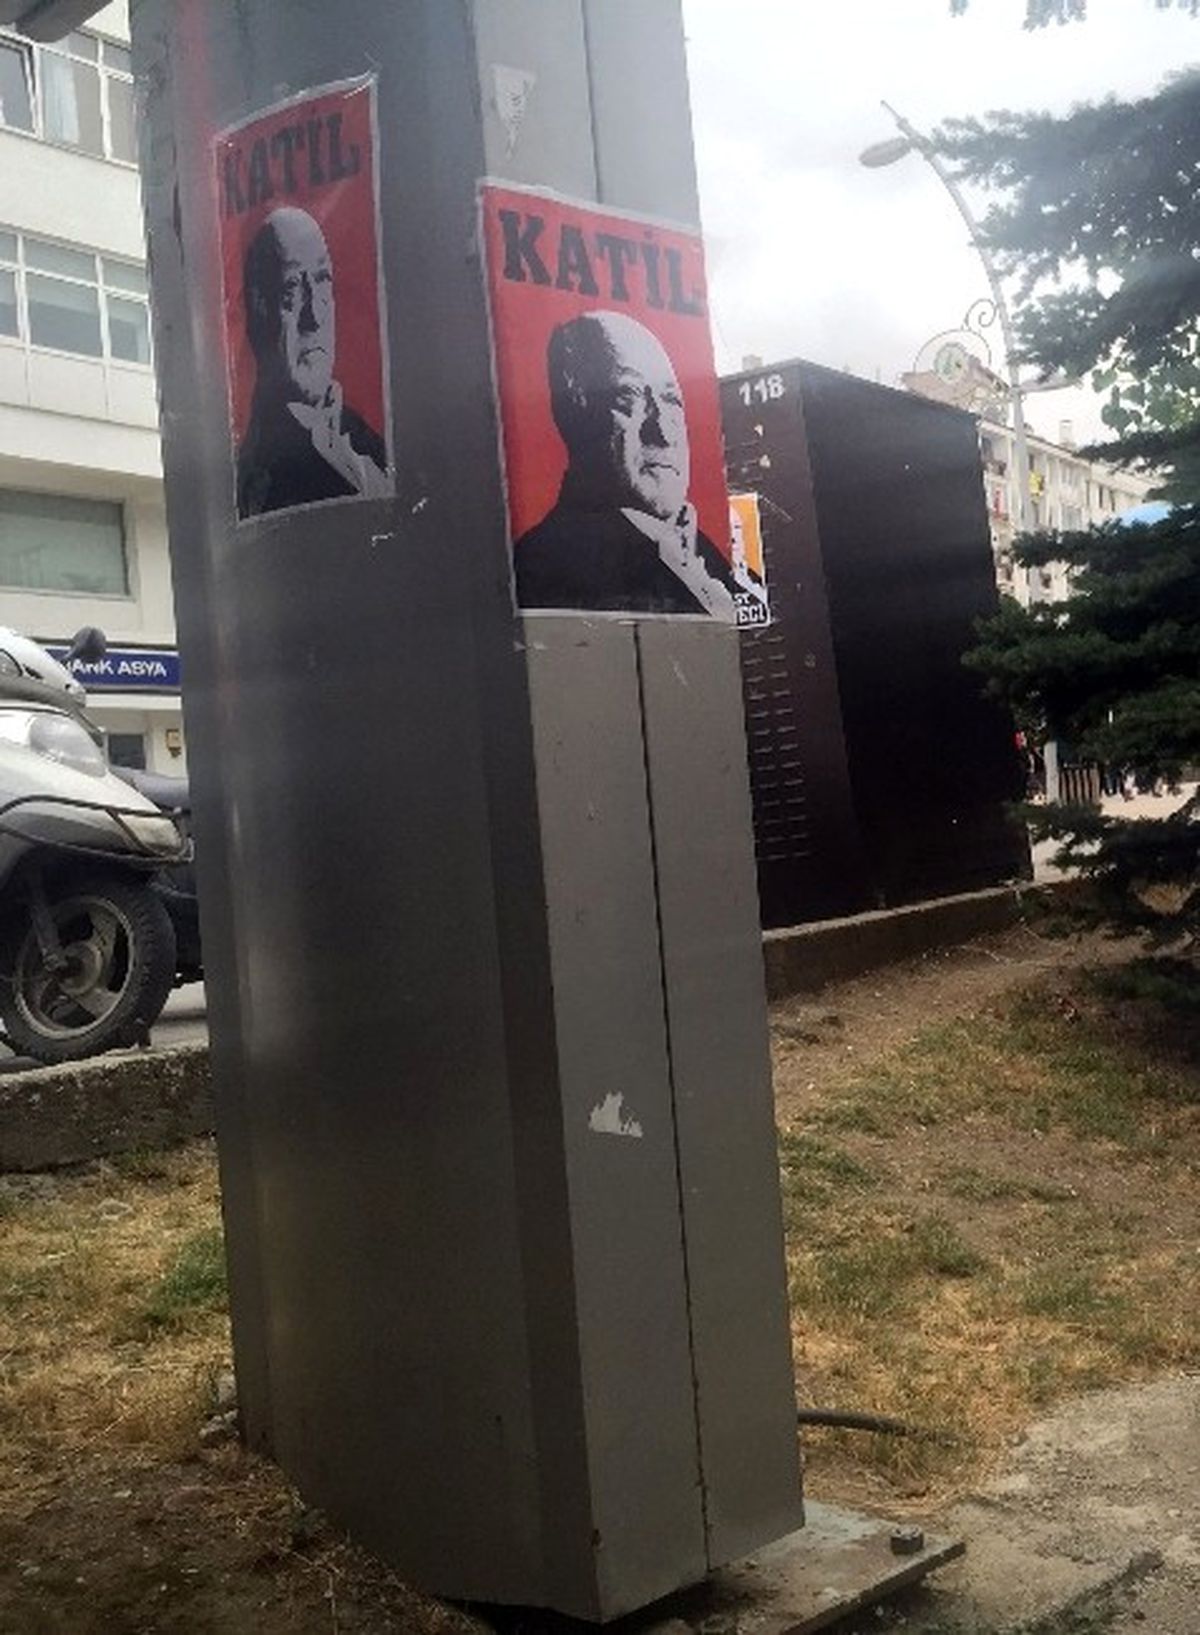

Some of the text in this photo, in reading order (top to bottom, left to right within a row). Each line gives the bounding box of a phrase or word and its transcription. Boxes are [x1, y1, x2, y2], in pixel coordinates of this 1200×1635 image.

[499, 209, 704, 317] KATİL
[739, 374, 785, 405] 118
[65, 658, 167, 677] ANK ASYA
